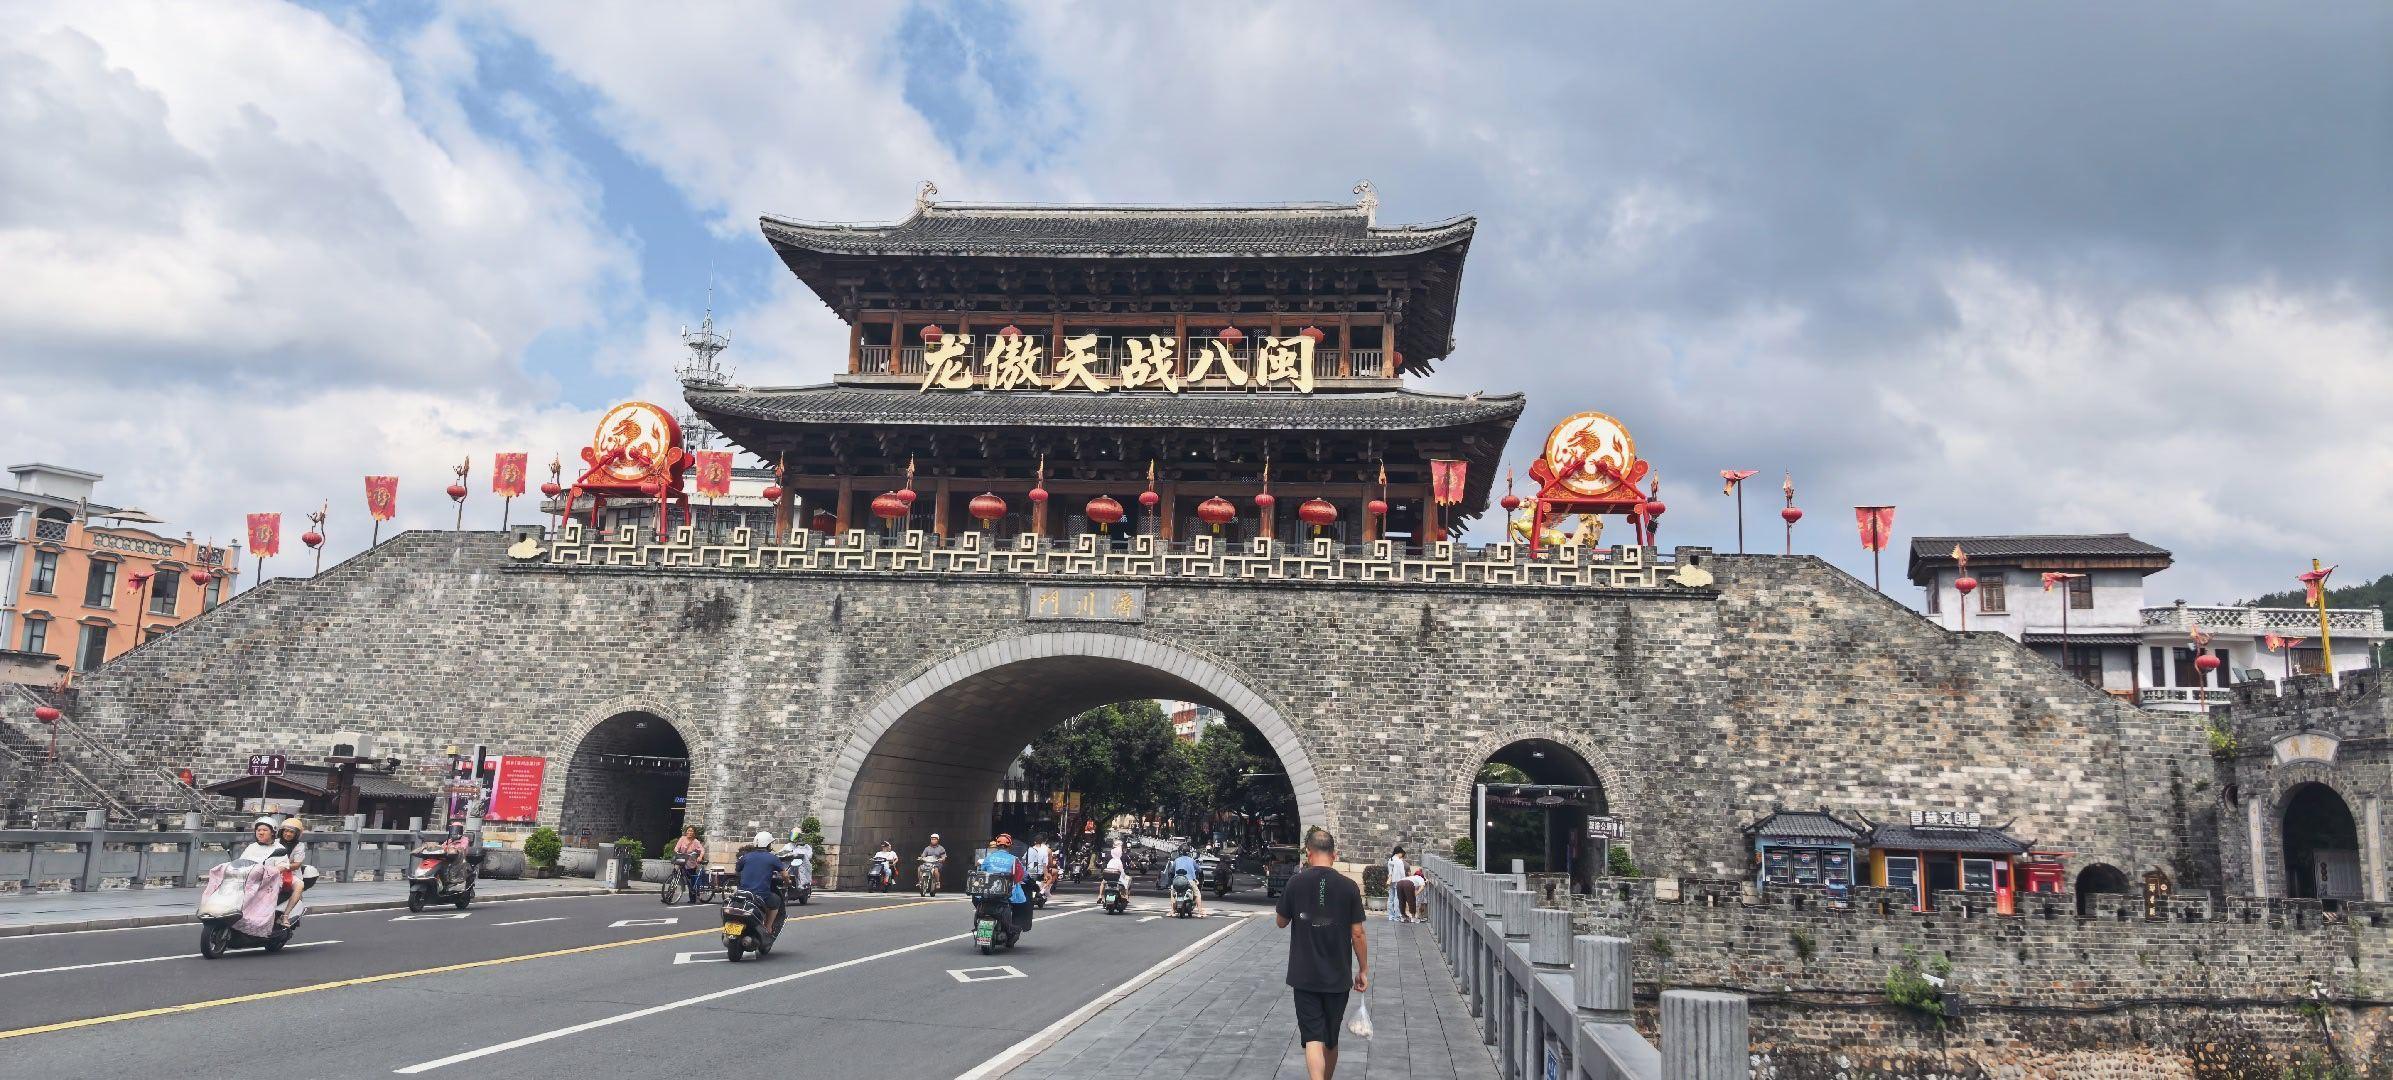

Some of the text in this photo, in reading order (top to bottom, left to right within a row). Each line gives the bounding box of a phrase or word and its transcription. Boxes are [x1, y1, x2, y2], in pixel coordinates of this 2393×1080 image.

[920, 333, 1316, 394] 龙傲天战八闽
